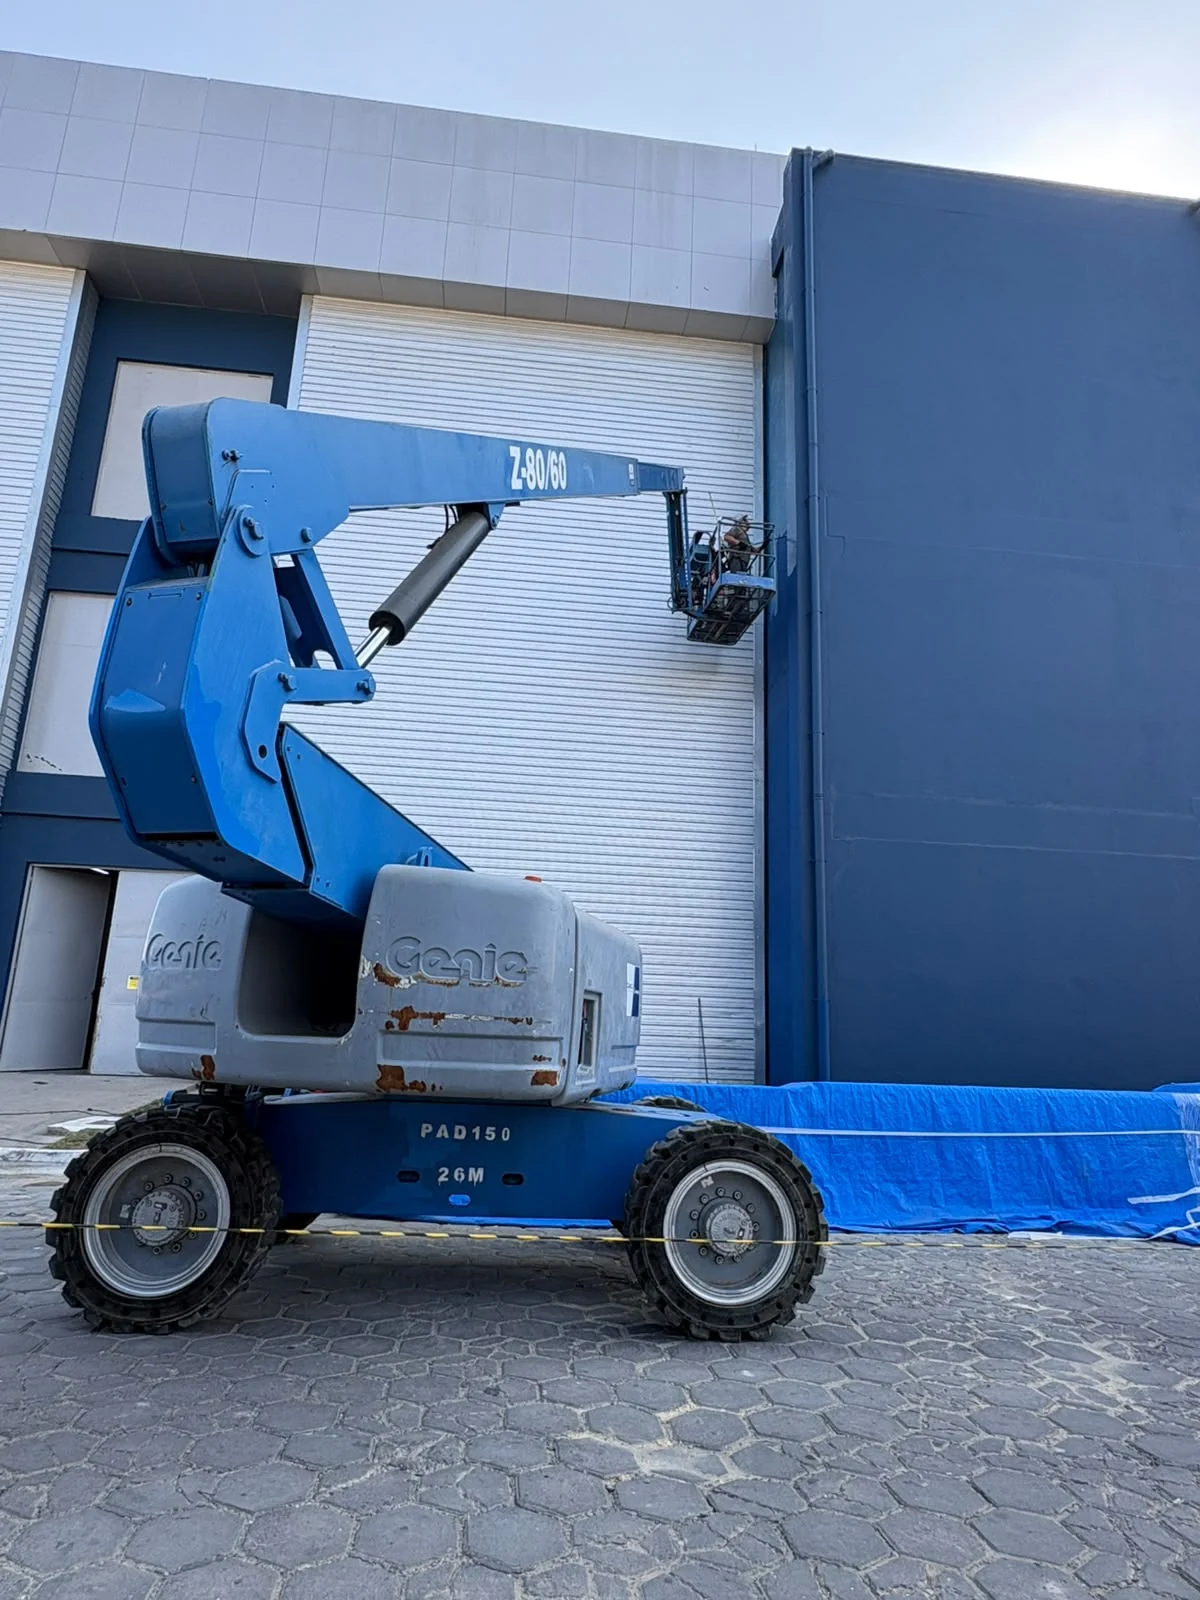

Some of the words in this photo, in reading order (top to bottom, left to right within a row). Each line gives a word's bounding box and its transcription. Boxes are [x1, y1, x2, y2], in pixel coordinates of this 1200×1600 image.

[509, 445, 567, 491] Z-80/60
[145, 933, 222, 970] Genie
[387, 936, 528, 982] Genie
[437, 1167, 485, 1186] 26M
